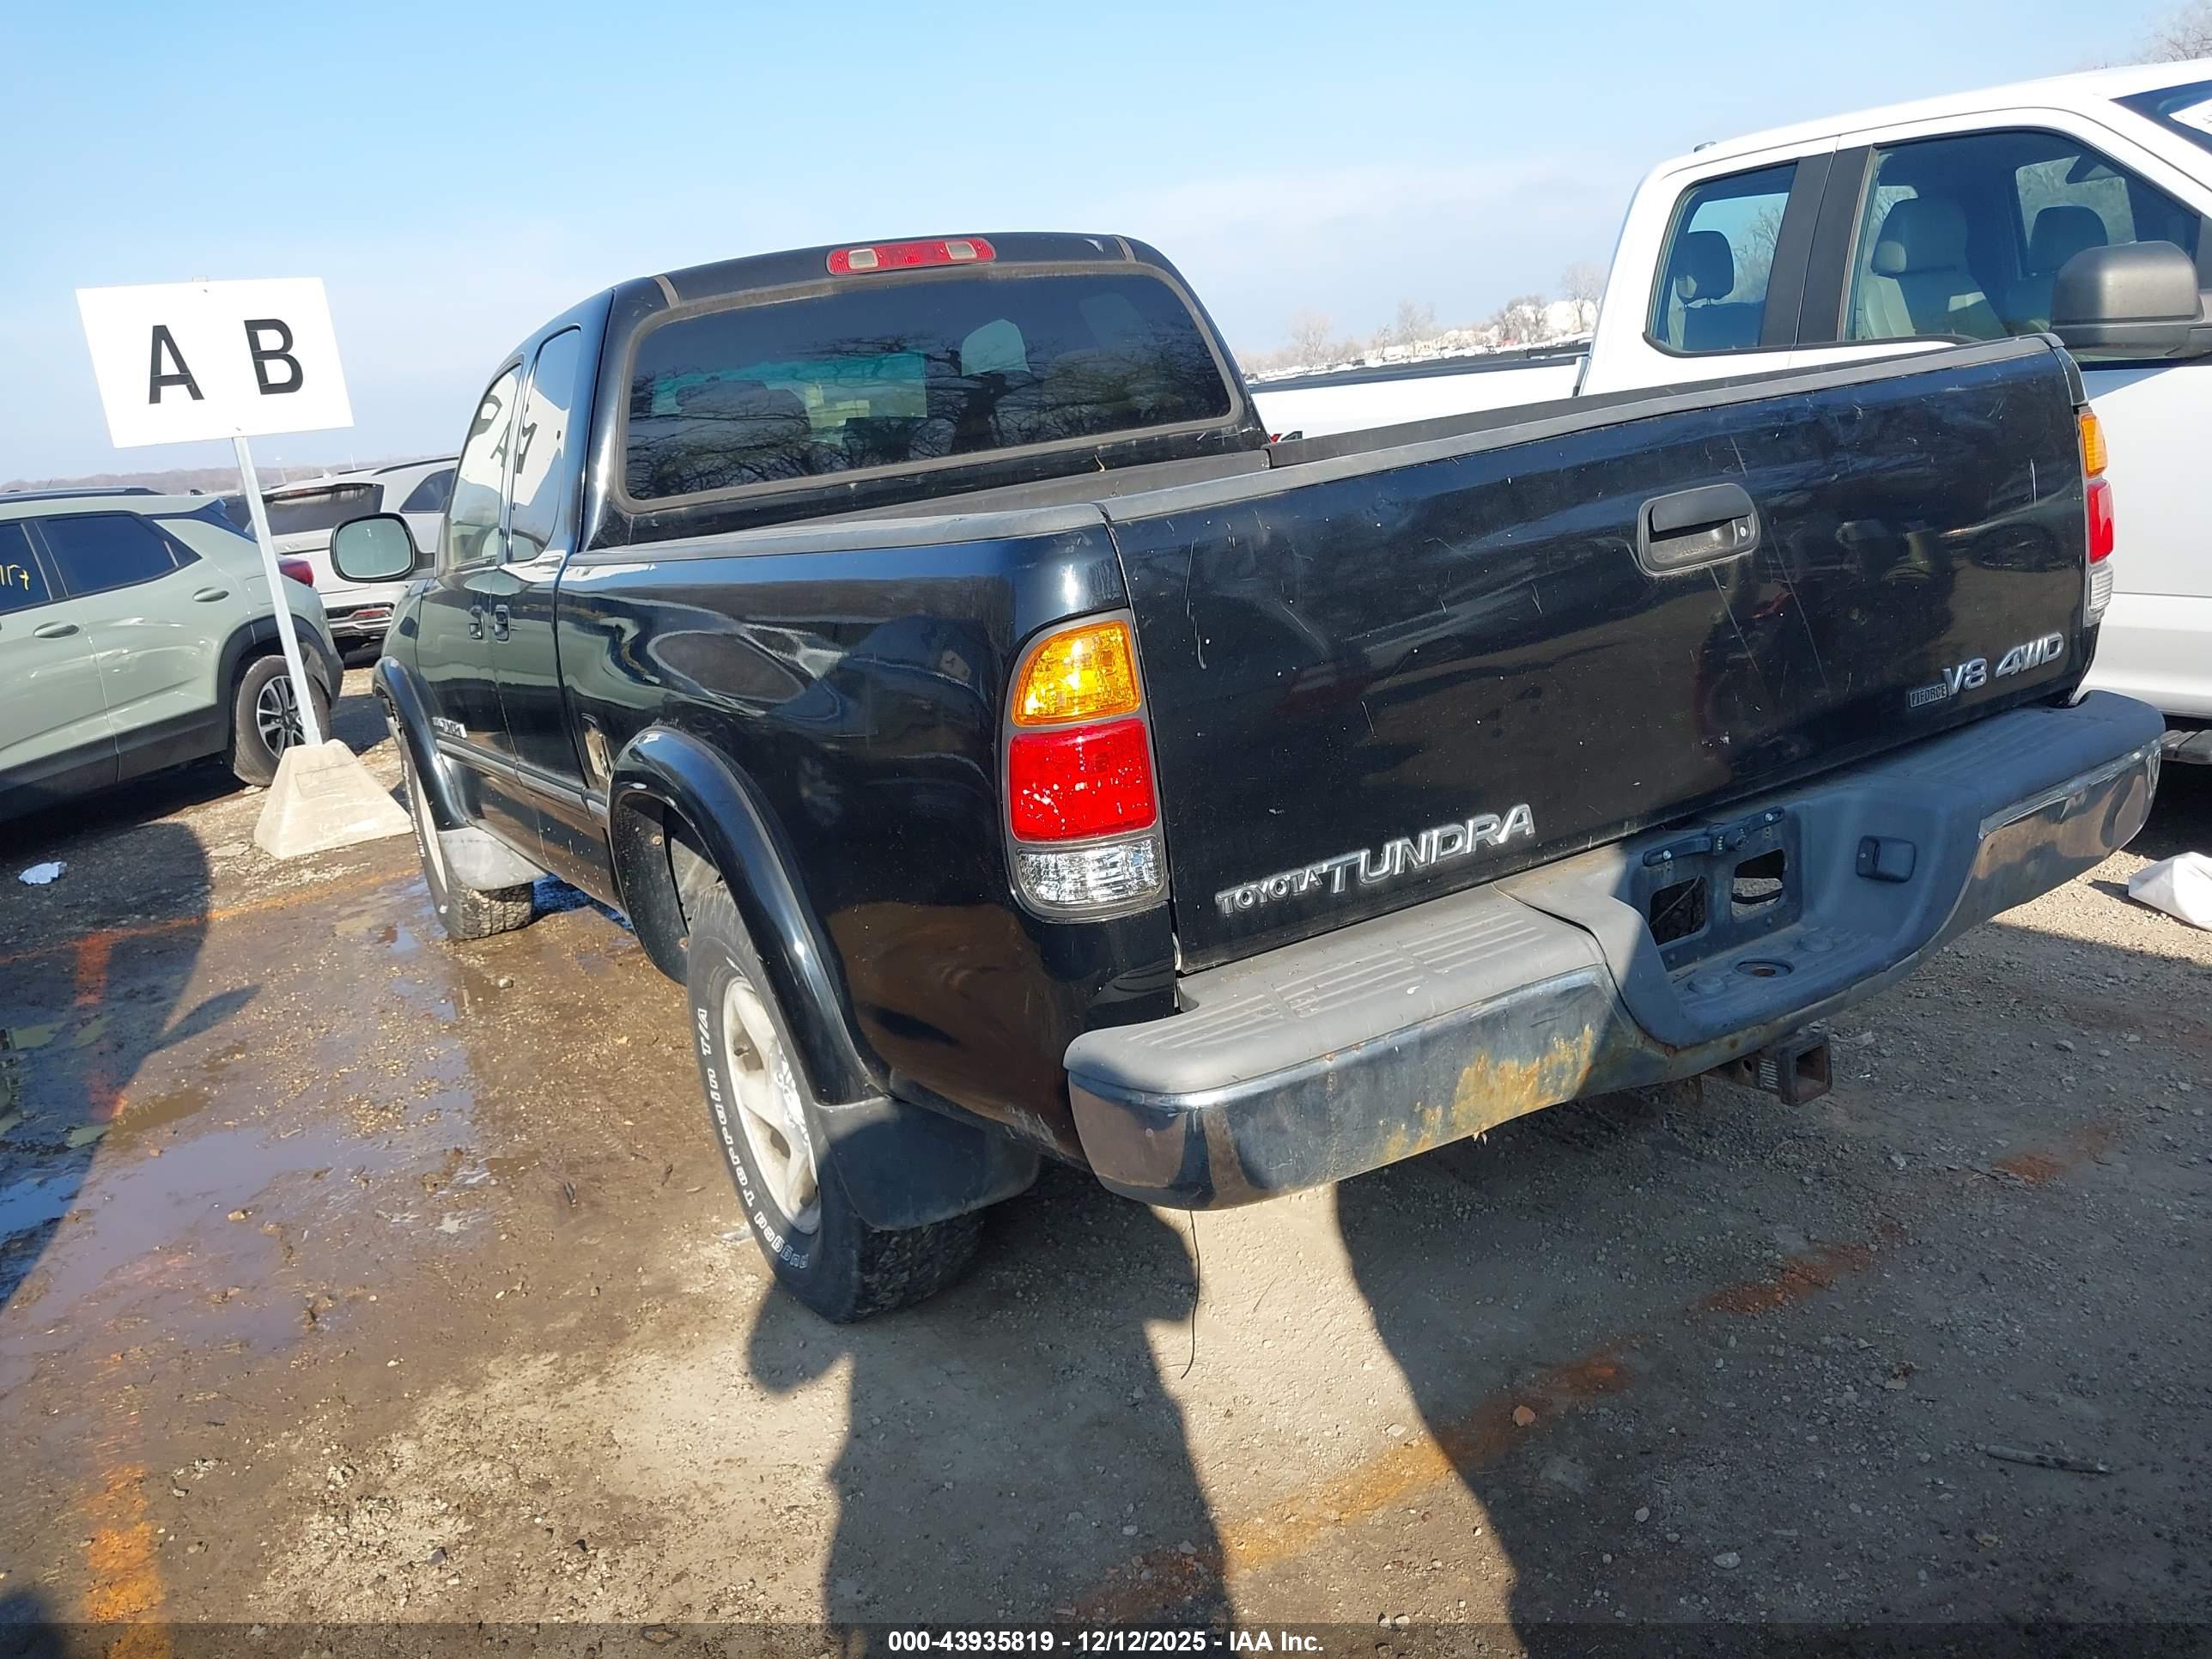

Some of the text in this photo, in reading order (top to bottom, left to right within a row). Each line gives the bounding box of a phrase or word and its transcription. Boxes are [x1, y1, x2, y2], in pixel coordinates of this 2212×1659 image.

[149, 319, 304, 404] A B
[1942, 658, 1988, 696] V8
[1995, 632, 2064, 678] 4WD
[1215, 803, 1536, 915] TOYOTA TUNDRA
[697, 1007, 712, 1056] T/A
